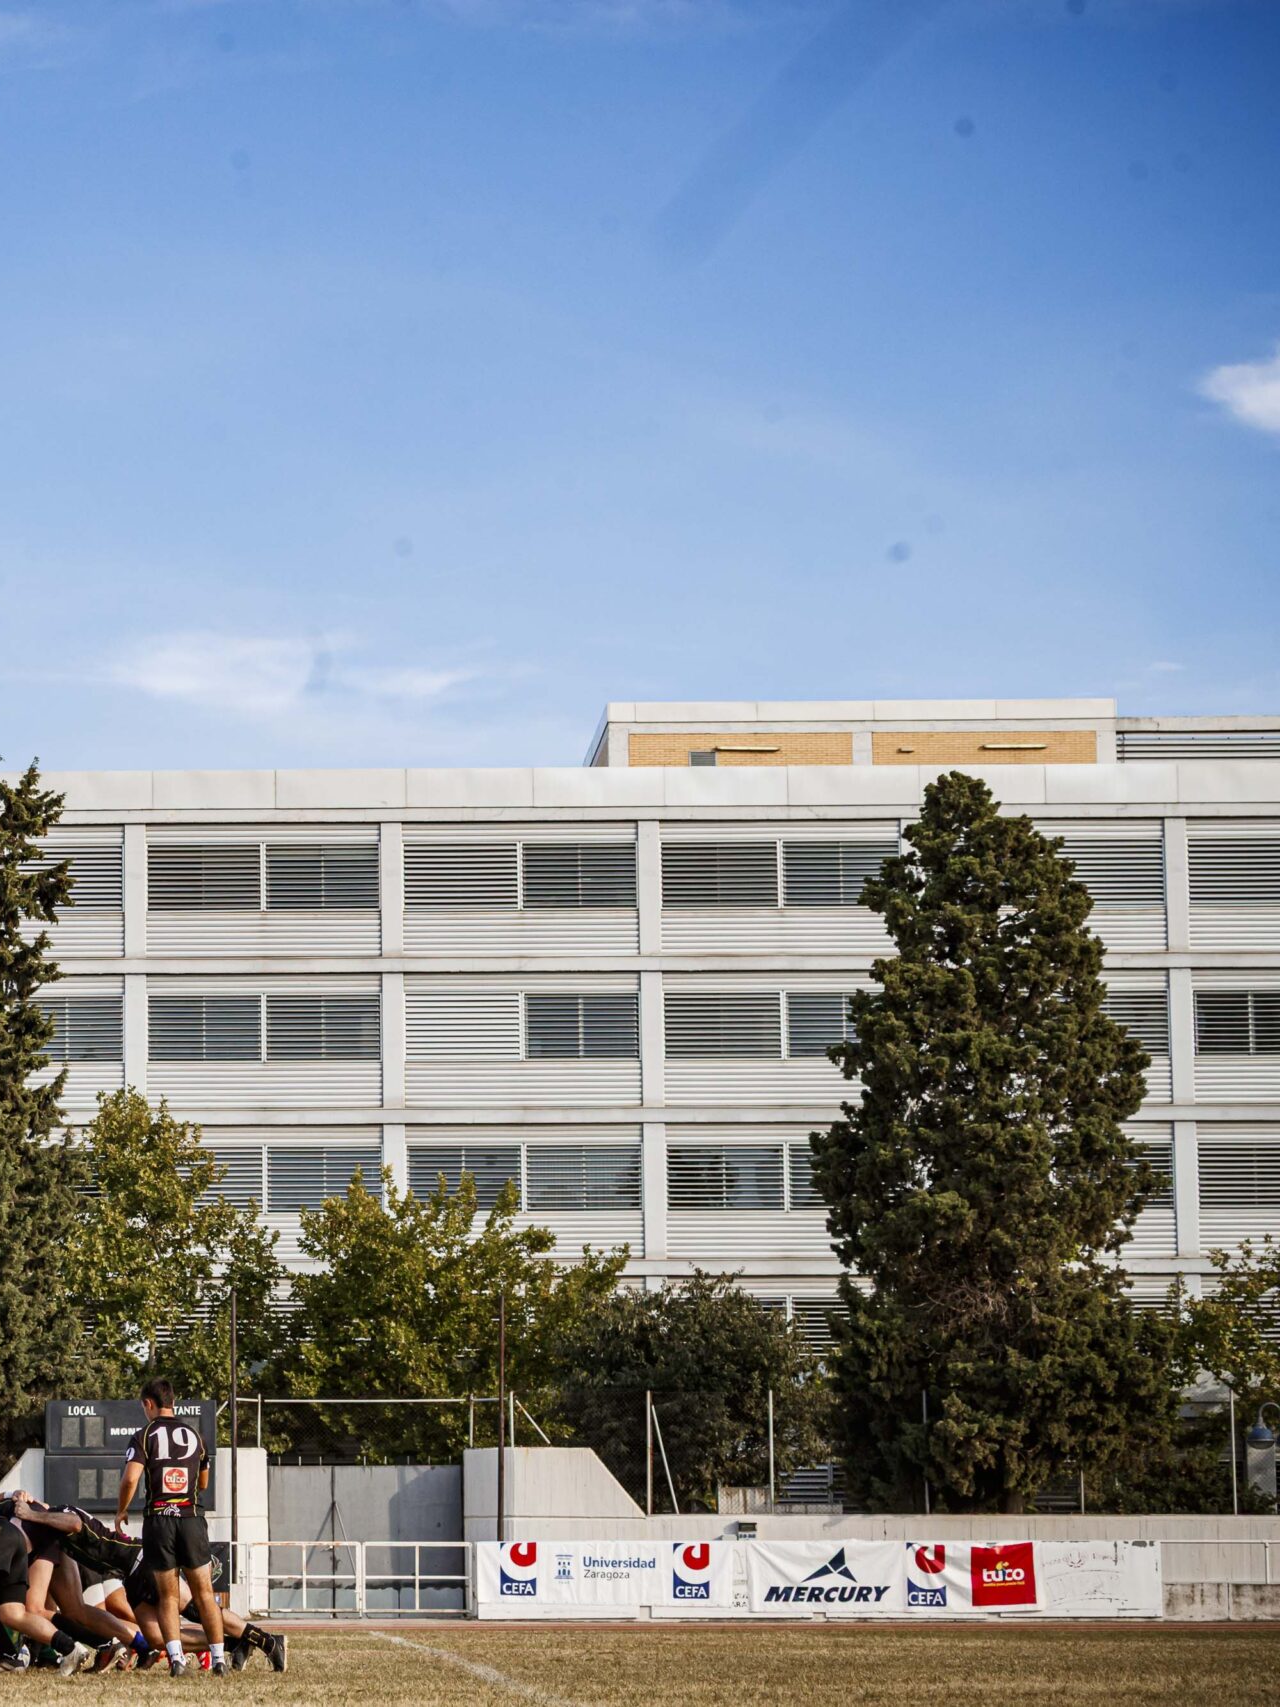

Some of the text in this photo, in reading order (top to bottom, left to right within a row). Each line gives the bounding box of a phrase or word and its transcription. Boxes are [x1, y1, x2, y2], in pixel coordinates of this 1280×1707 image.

[68, 1406, 96, 1416] LOCAL
[173, 1405, 201, 1416] TANTE
[110, 1427, 143, 1436] MON
[149, 1426, 198, 1460] 19
[583, 1556, 656, 1569] Universidad
[584, 1569, 630, 1580] Zaragoza
[982, 1568, 1025, 1583] tuco
[502, 1582, 534, 1595] CEFA
[675, 1586, 708, 1598] CEFA
[764, 1586, 891, 1603] MERCURY
[908, 1591, 945, 1605] CEFA
